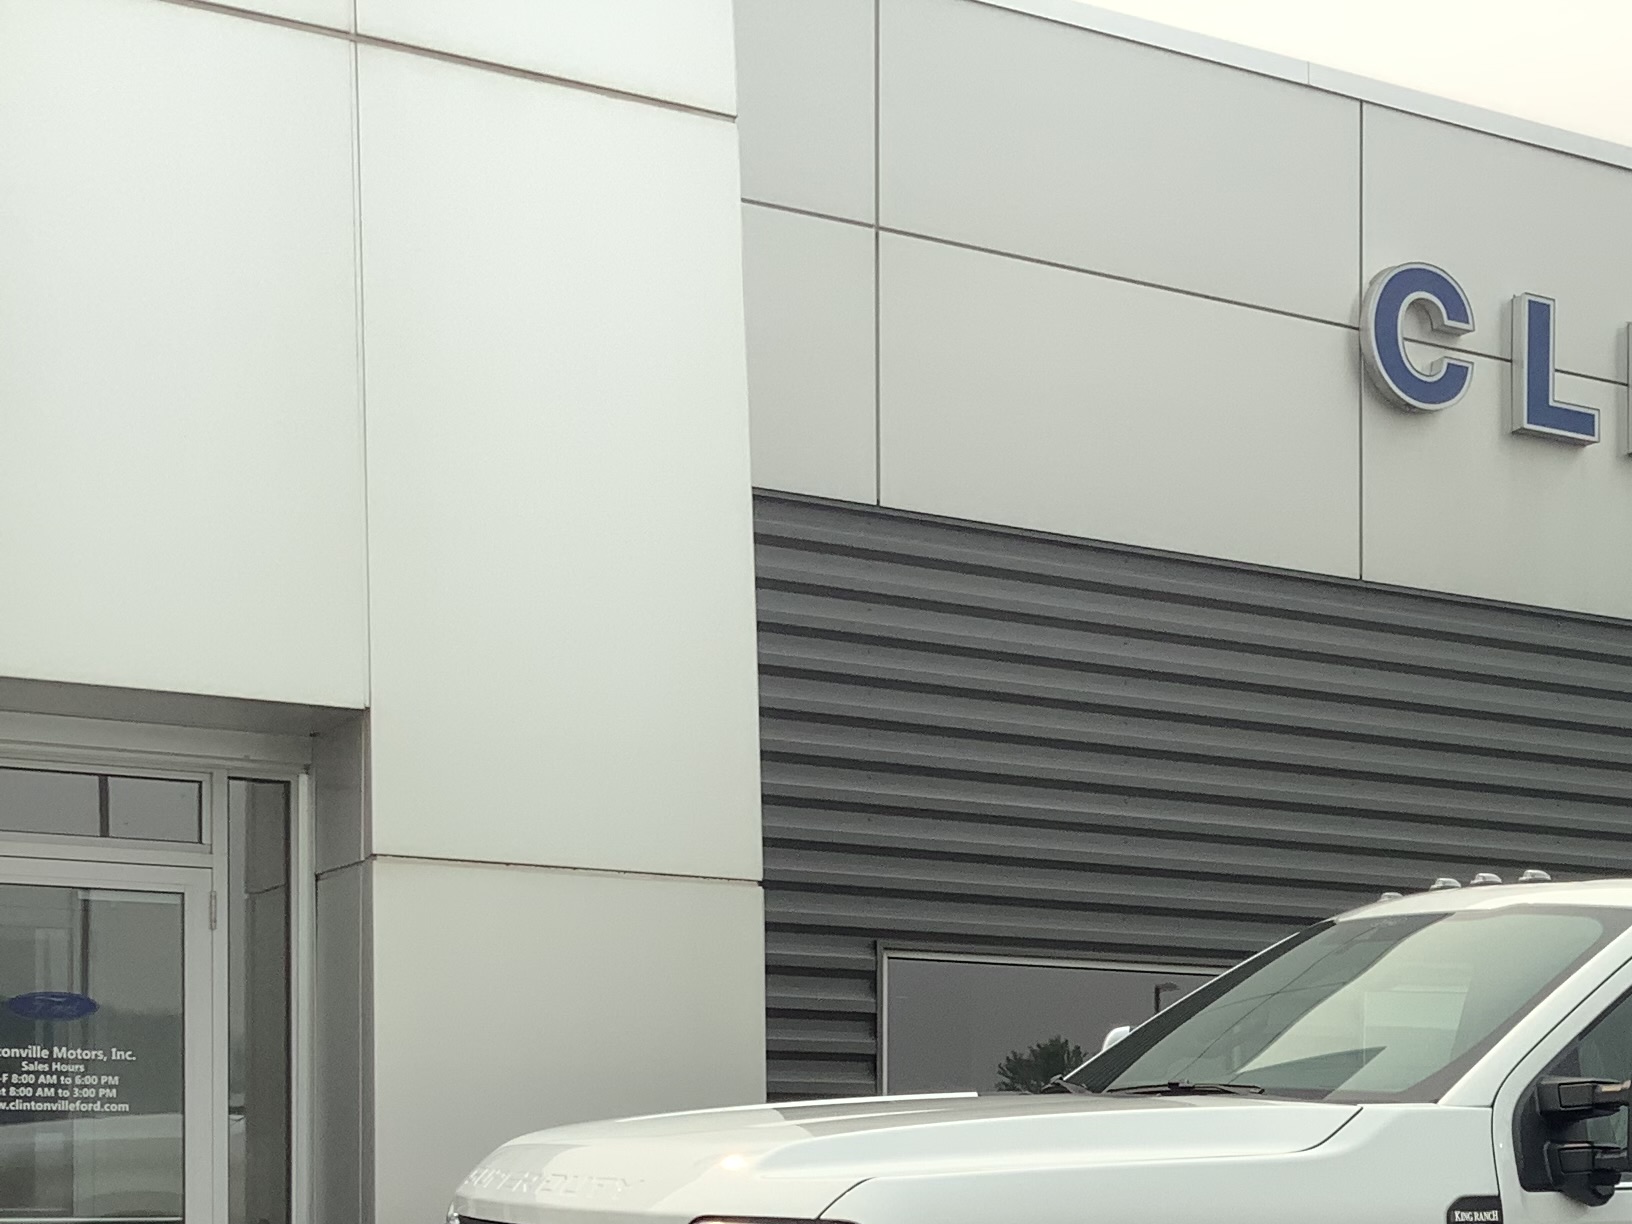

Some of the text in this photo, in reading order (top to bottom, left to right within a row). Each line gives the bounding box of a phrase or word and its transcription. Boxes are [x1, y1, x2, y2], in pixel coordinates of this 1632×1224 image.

[0, 1045, 137, 1061] onville Motors, Inc.
[21, 1061, 86, 1072] Sales Hours
[11, 1074, 36, 1084] 8:00
[38, 1074, 58, 1084] AM
[60, 1076, 73, 1084] to
[75, 1075, 99, 1085] 6:00
[101, 1076, 119, 1085] PM
[9, 1087, 33, 1097] 8:00
[35, 1087, 55, 1097] AM
[58, 1088, 70, 1097] to
[73, 1088, 96, 1098] 3:00
[99, 1088, 117, 1098] PM
[1454, 1210, 1499, 1222] KING RANCH
